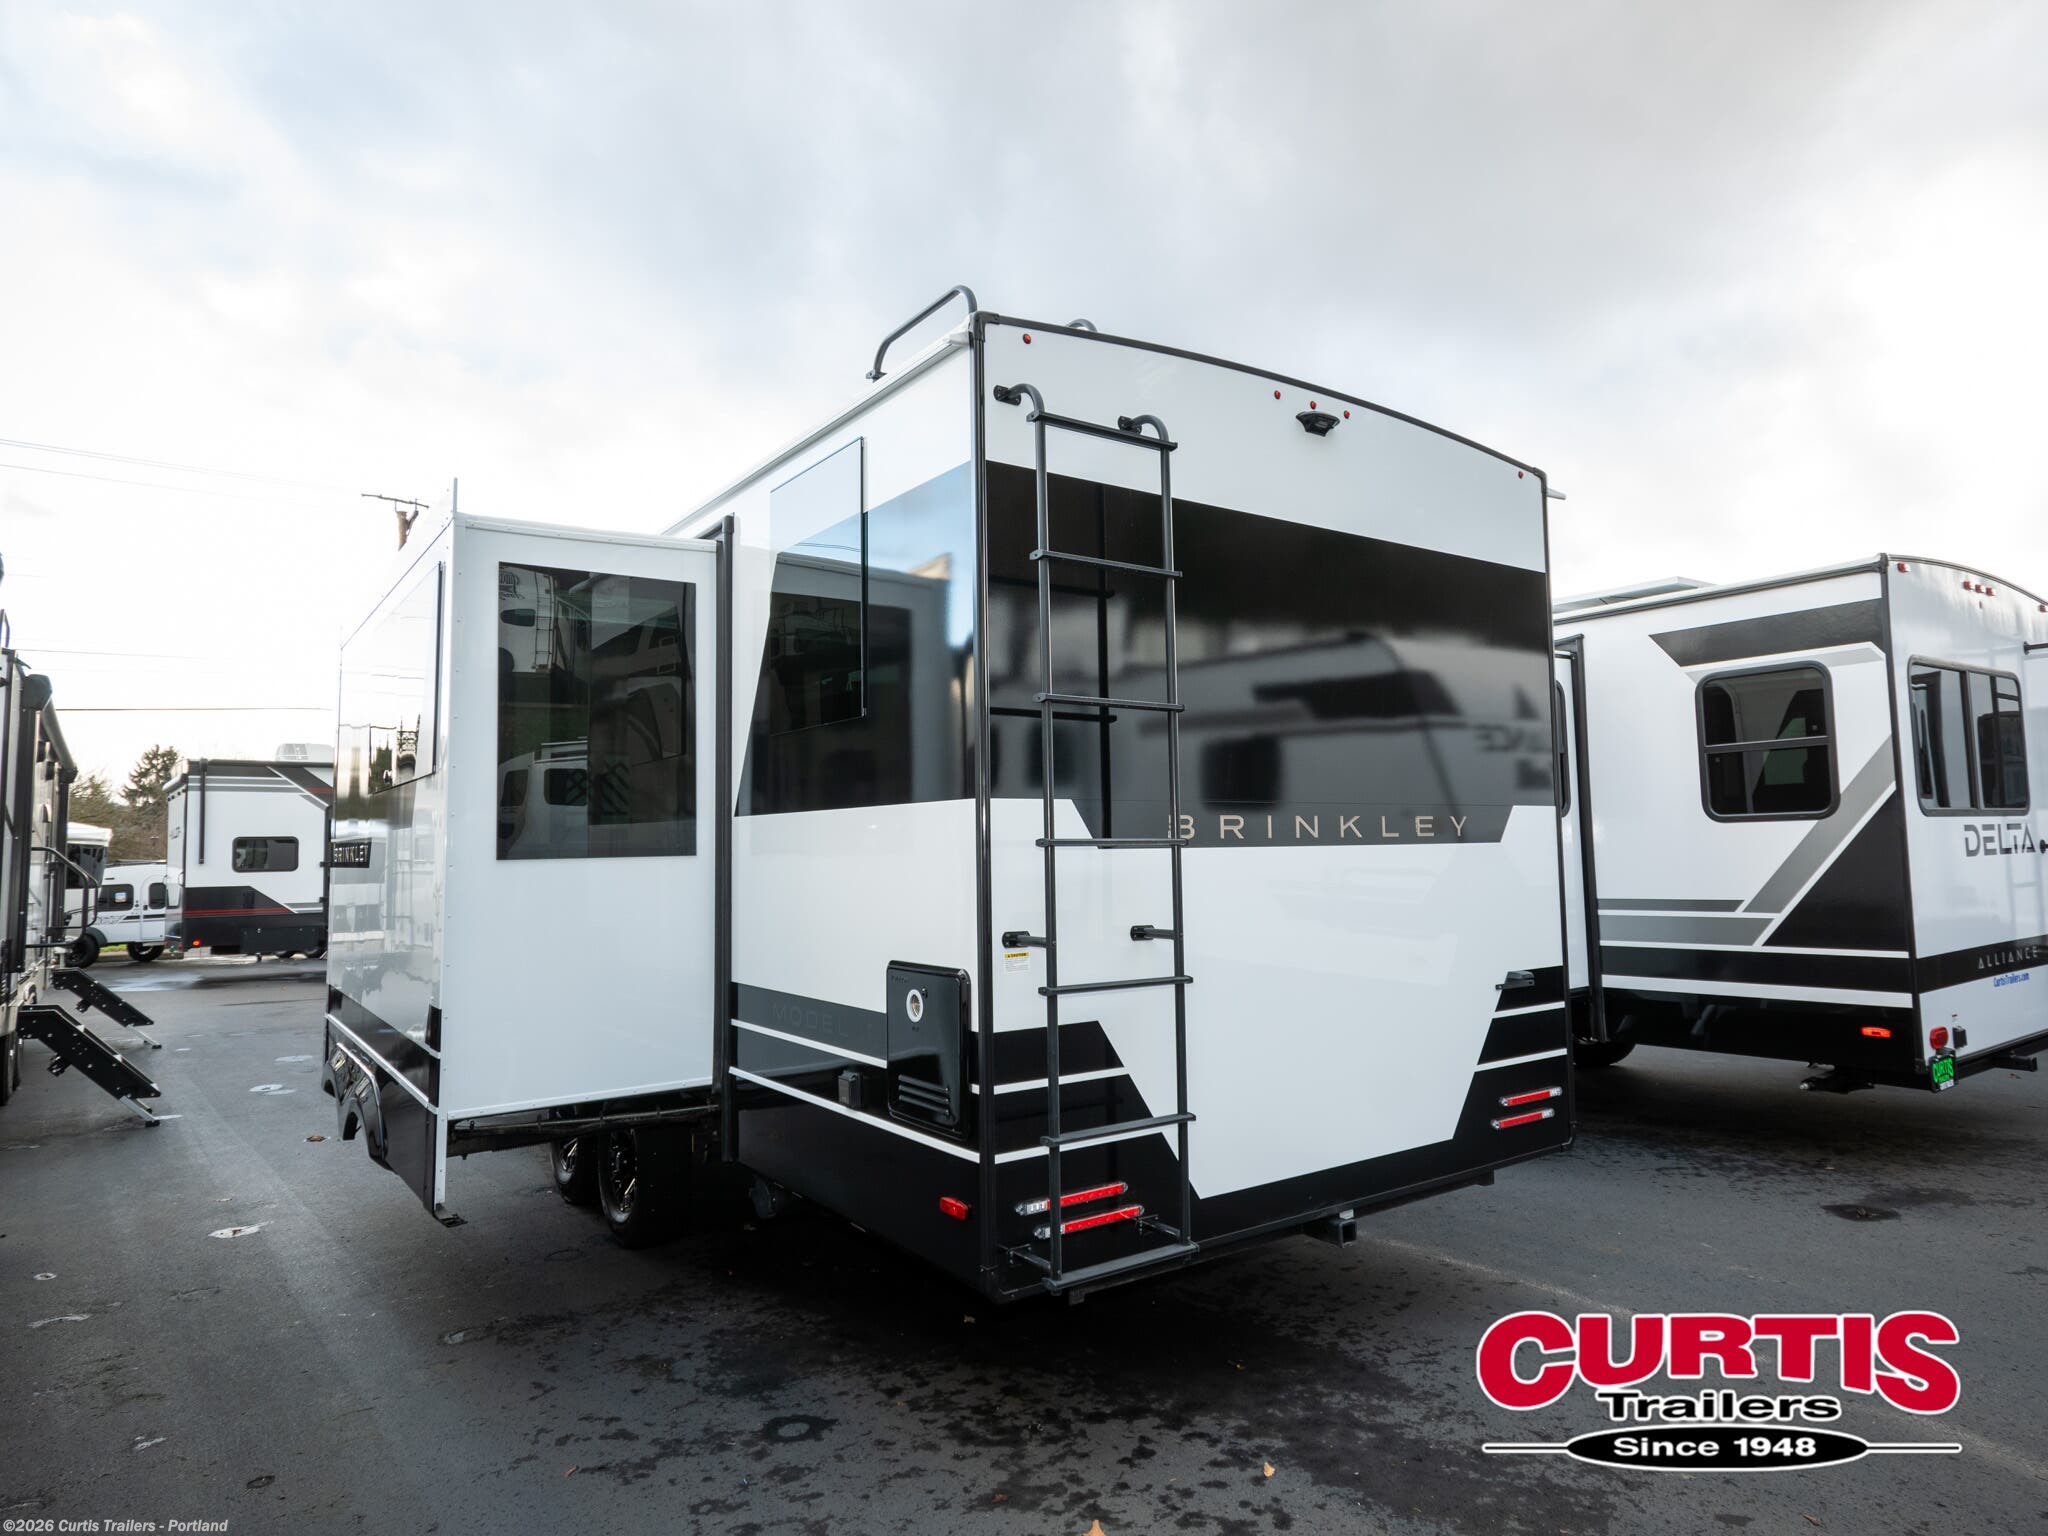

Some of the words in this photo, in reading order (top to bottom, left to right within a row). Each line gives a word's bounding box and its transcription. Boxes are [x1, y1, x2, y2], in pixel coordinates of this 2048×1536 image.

[1167, 813, 1468, 840] BRINKLEY
[1963, 823, 2037, 857] DELTA
[1977, 945, 2039, 970] ALLIANCE
